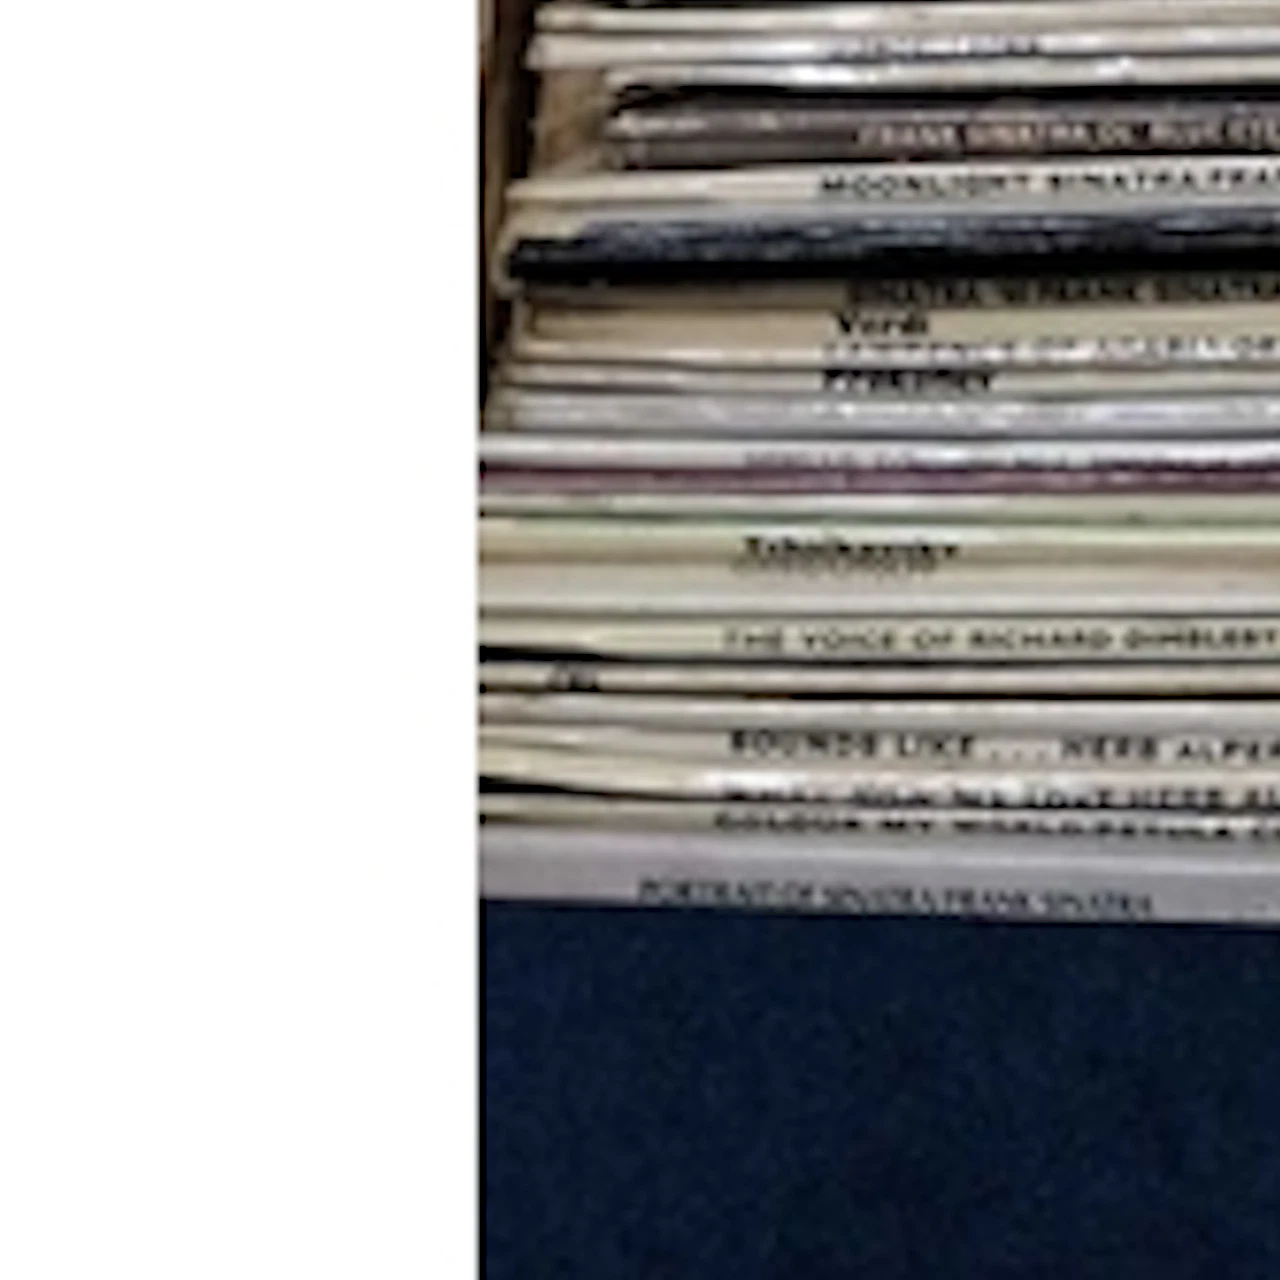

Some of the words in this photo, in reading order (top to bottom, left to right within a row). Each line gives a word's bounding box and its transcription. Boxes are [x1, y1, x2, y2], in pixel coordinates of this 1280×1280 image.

[818, 173, 1032, 199] MOONLIGHT
[831, 311, 931, 336] Verdi
[720, 627, 786, 653] THE
[804, 628, 894, 653] VOICE
[911, 627, 957, 652] OF
[969, 627, 1111, 651] RICHARD
[728, 728, 879, 759] SOUNDS
